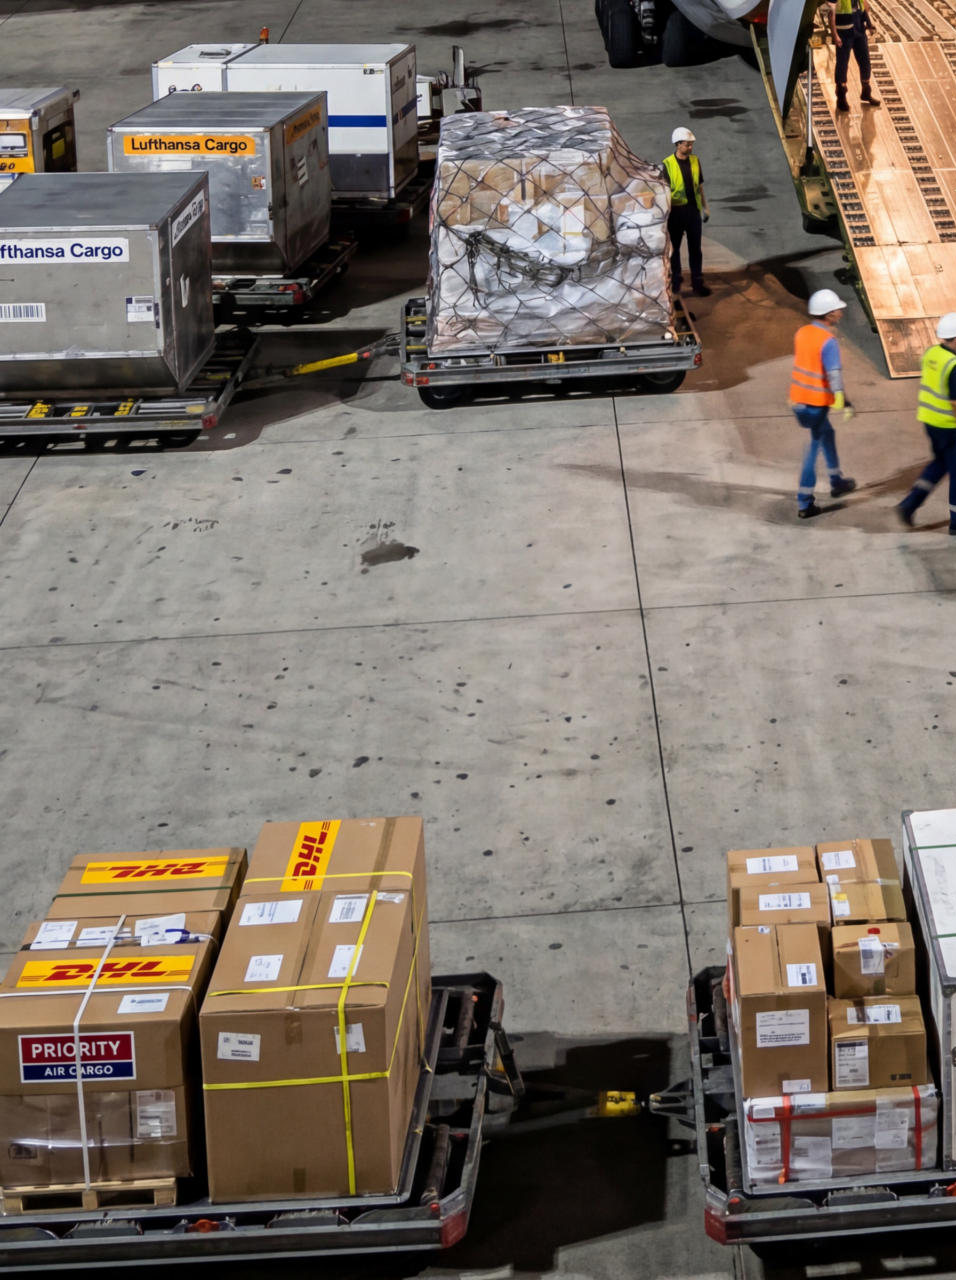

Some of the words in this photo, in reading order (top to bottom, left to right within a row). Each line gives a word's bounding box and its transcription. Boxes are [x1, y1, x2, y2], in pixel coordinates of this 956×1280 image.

[131, 138, 200, 151] Lufthansa
[204, 138, 248, 154] Cargo
[70, 243, 124, 260] Cargo
[291, 831, 328, 882] DHL
[108, 862, 208, 879] DHL
[42, 961, 168, 981] DHL
[31, 1040, 120, 1058] PRIORITY
[44, 1067, 65, 1077] AIR
[69, 1065, 113, 1076] CARGO
